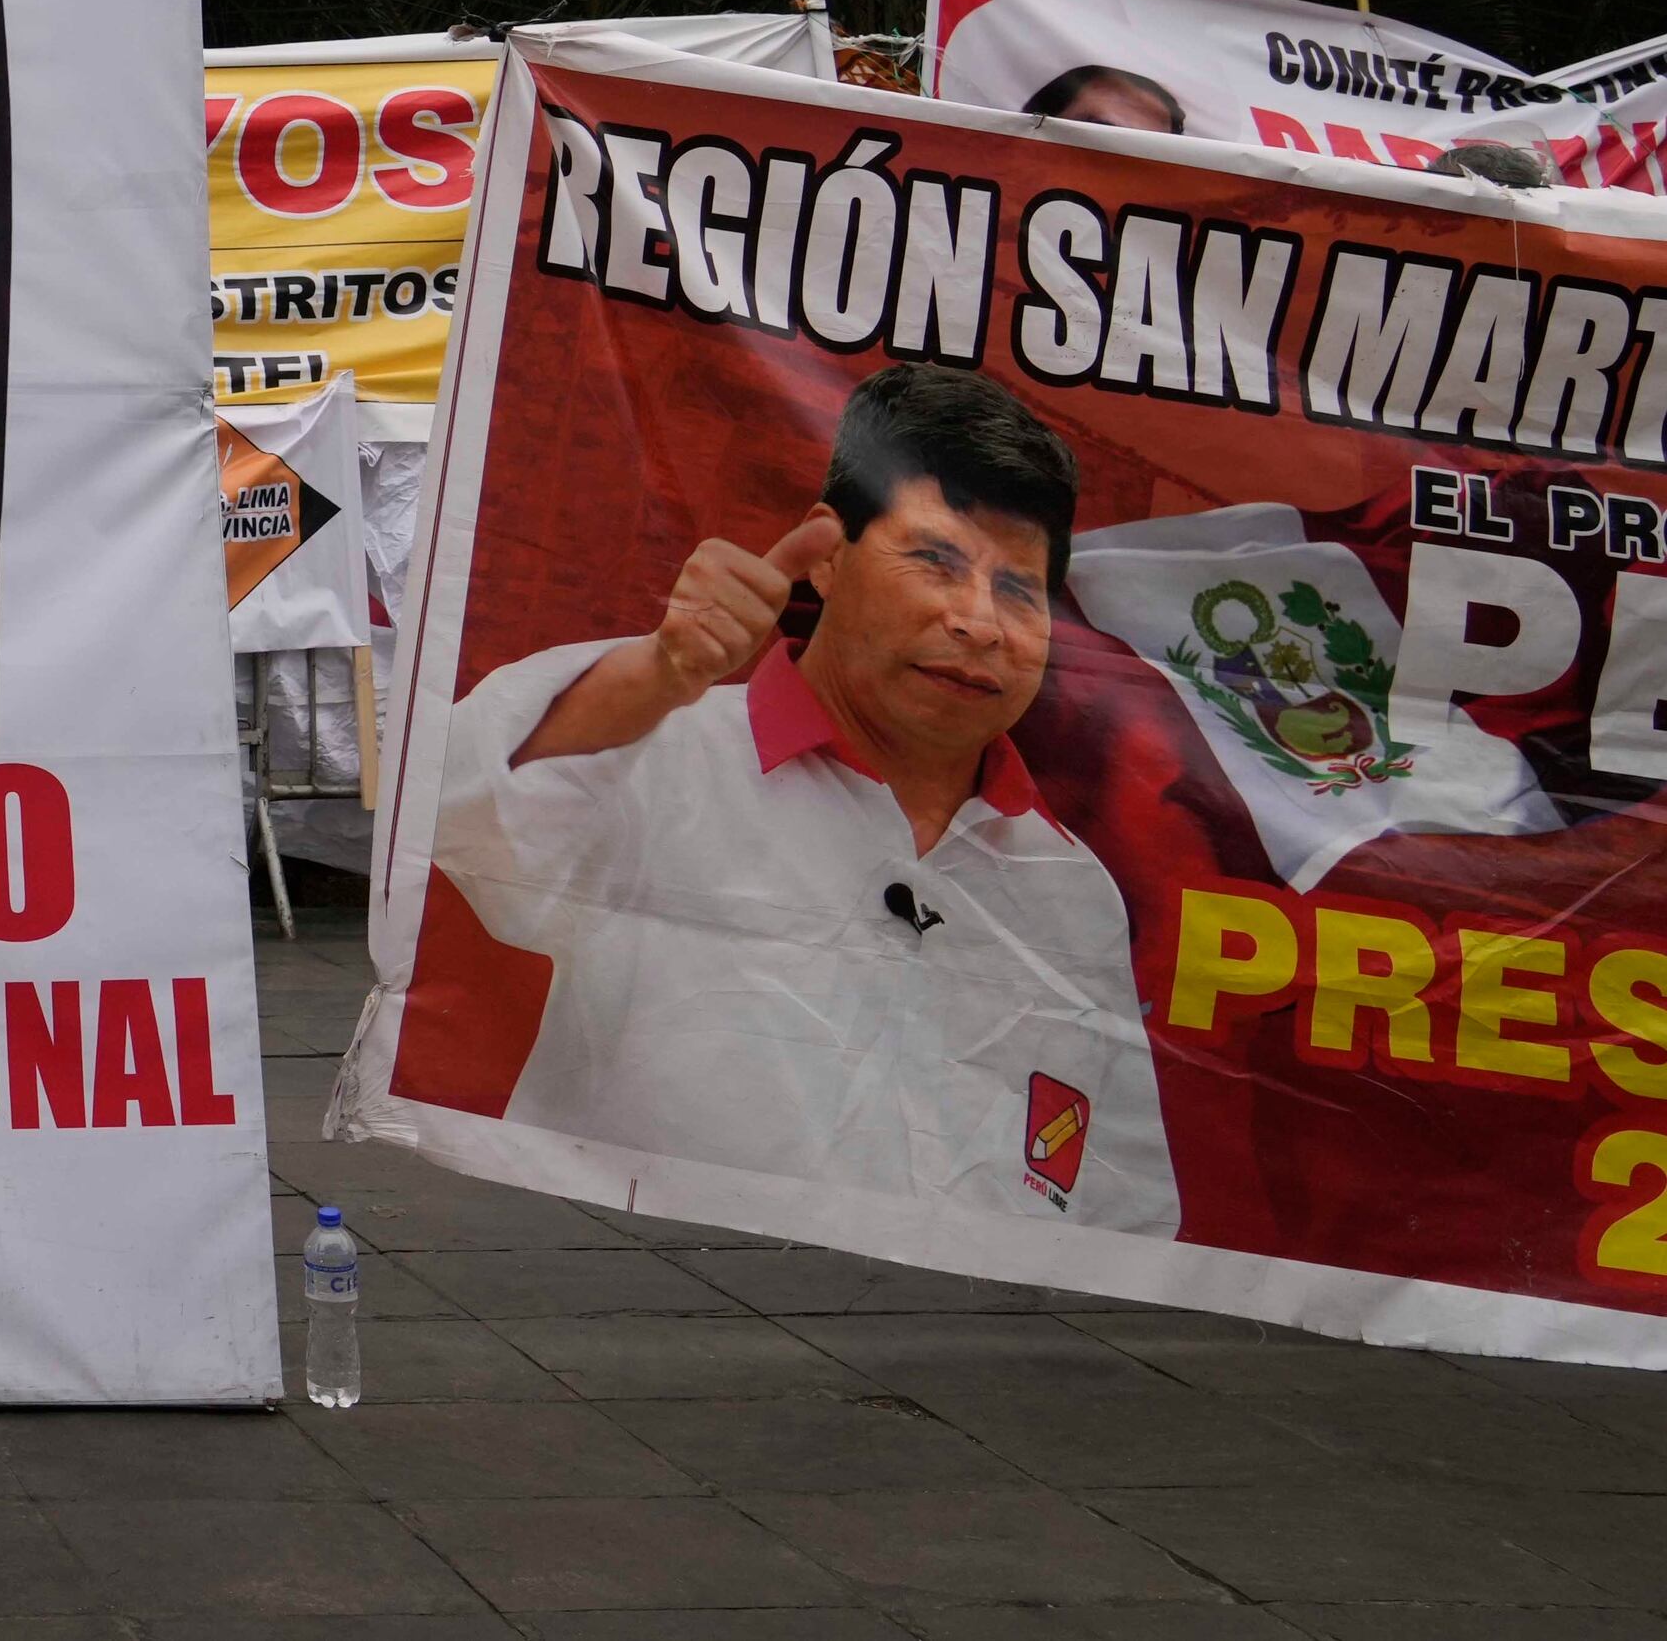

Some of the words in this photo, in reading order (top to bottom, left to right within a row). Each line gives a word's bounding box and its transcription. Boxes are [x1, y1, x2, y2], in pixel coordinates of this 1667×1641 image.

[1265, 31, 1449, 112] COMITÉ
[543, 106, 995, 359] REGIÓN
[1020, 199, 1294, 405] SAN
[237, 486, 290, 510] LIMA
[1410, 463, 1514, 544] EL
[1547, 484, 1667, 564] PR
